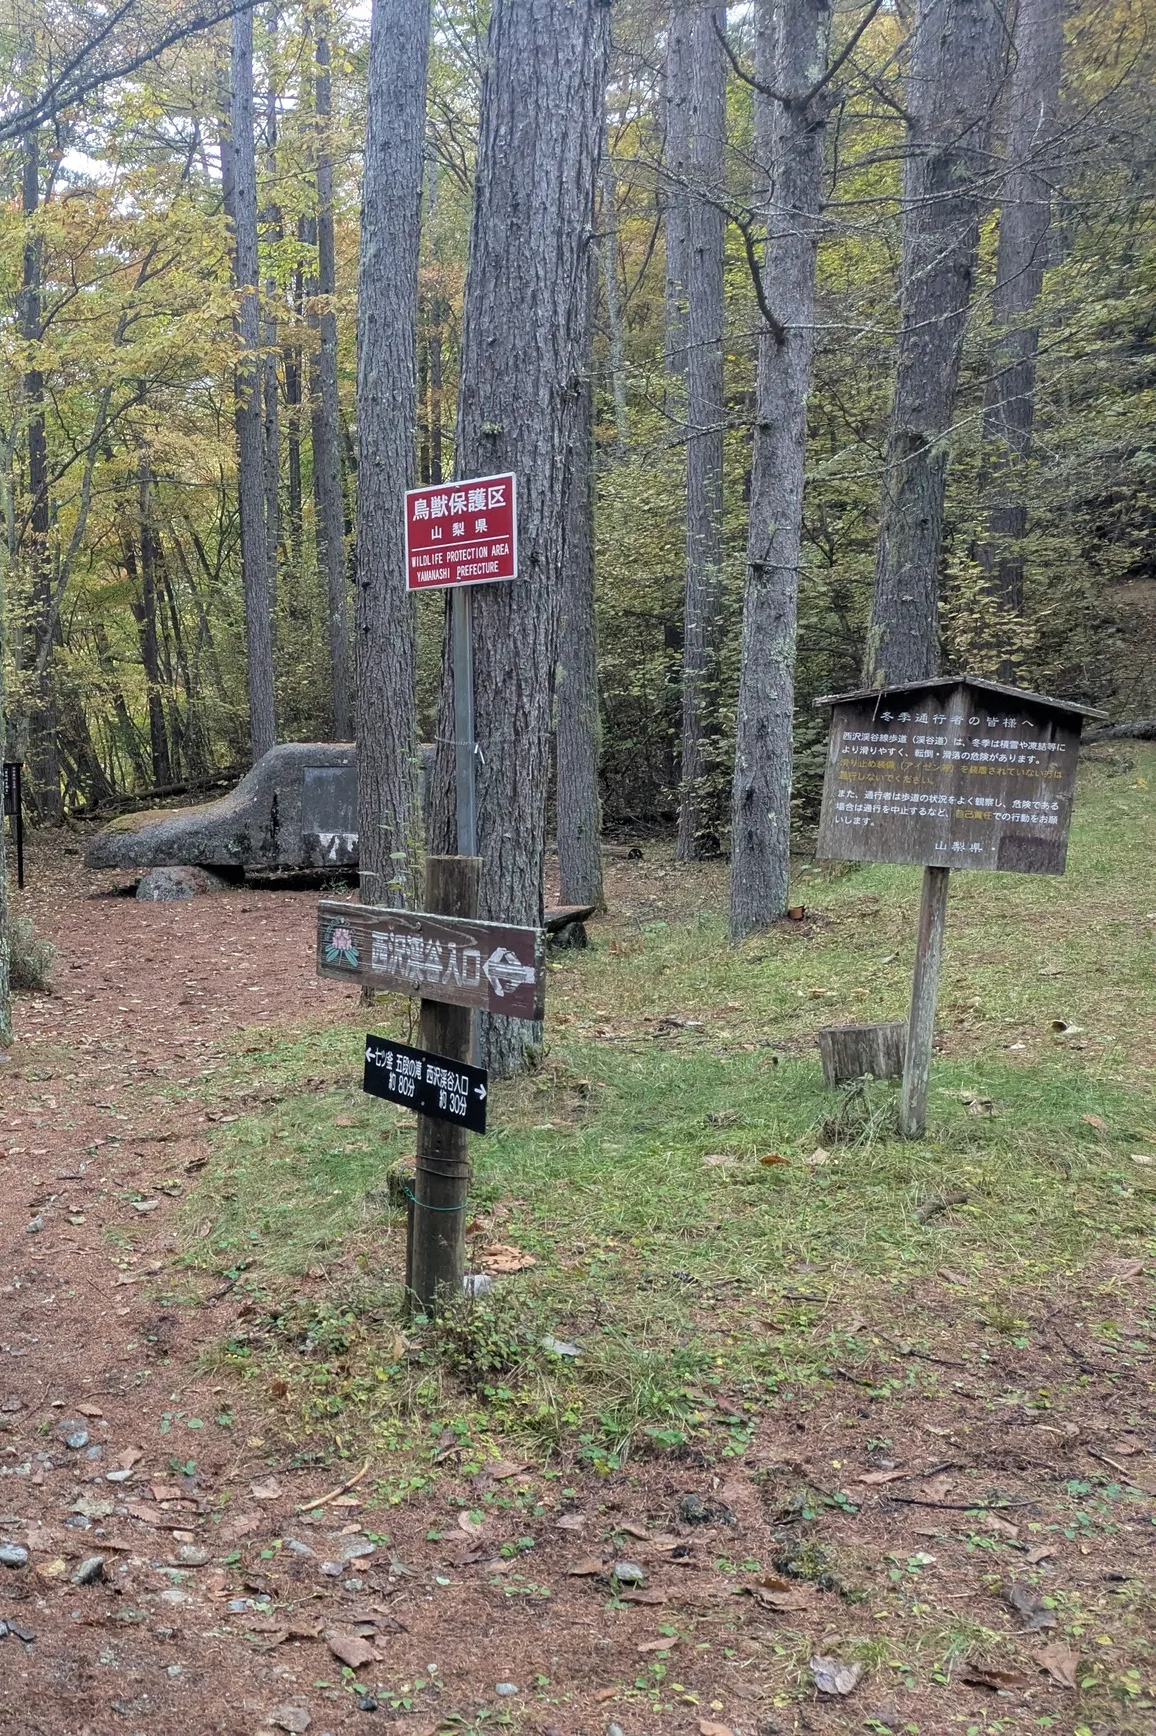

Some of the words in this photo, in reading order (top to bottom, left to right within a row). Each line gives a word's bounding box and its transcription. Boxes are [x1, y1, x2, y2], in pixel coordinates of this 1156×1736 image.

[412, 485, 506, 521] 鳥獣保護区
[431, 518, 488, 540] 山梨県
[411, 552, 443, 568] WILDLIFE
[446, 546, 488, 563] PROTECTION
[491, 543, 509, 557] AREA
[416, 567, 450, 583] YAMANASHI
[456, 561, 499, 578] PREFECTURE
[880, 711, 1034, 728] 冬季通行者の皆様へ
[835, 815, 874, 827] いします。
[934, 841, 983, 853] 山梨県
[371, 930, 481, 988] 西沢渓谷入口
[374, 1047, 394, 1070] 七ツ釜
[396, 1053, 422, 1080] 五段の滝
[426, 1064, 469, 1096] 西沢渓谷入口
[388, 1071, 396, 1091] 約
[398, 1075, 415, 1098] 80分
[438, 1089, 447, 1110] 約
[449, 1093, 467, 1117] 30分
